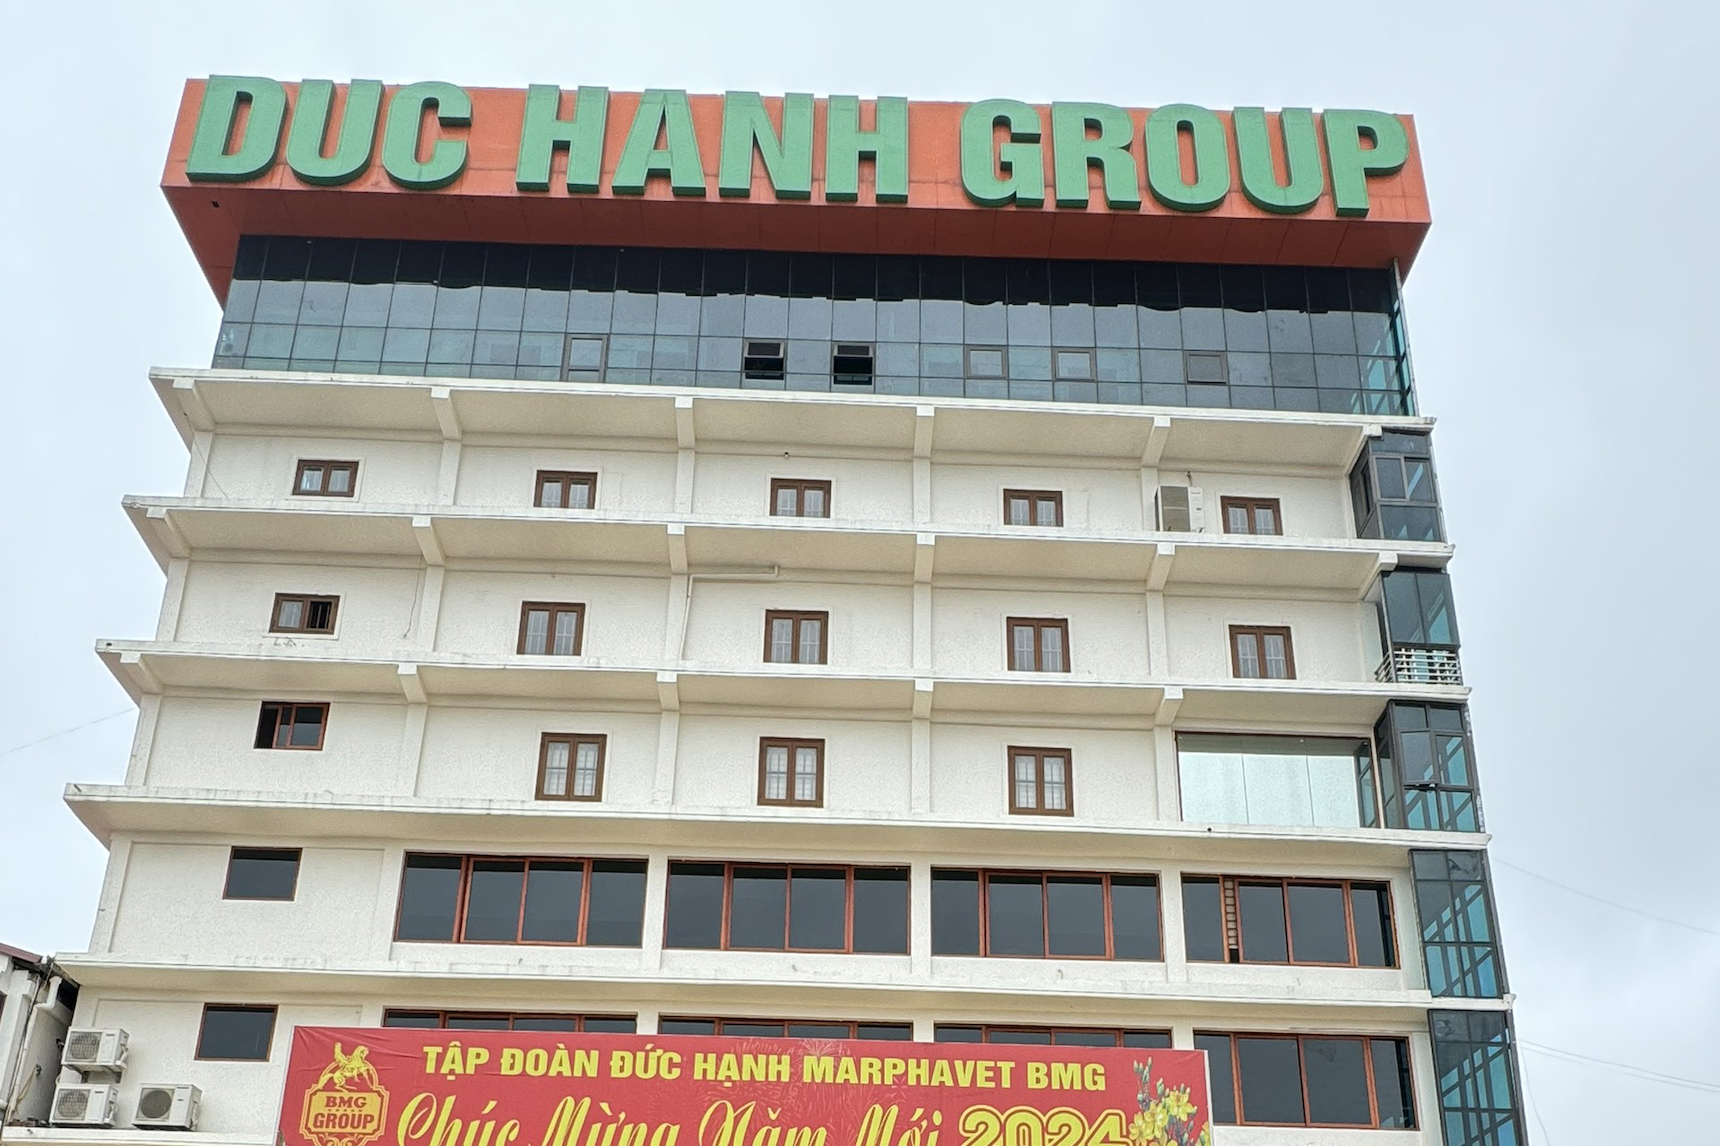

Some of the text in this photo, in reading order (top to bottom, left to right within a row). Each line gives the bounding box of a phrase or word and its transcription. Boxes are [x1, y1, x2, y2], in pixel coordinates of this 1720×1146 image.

[185, 74, 1409, 217] DUC HANH GROUP
[423, 1041, 1106, 1091] TẬP ĐOÀN ĐỨC HẠNH MARPHAVET BMG
[325, 1096, 367, 1108] BMG
[313, 1113, 374, 1129] GROUP
